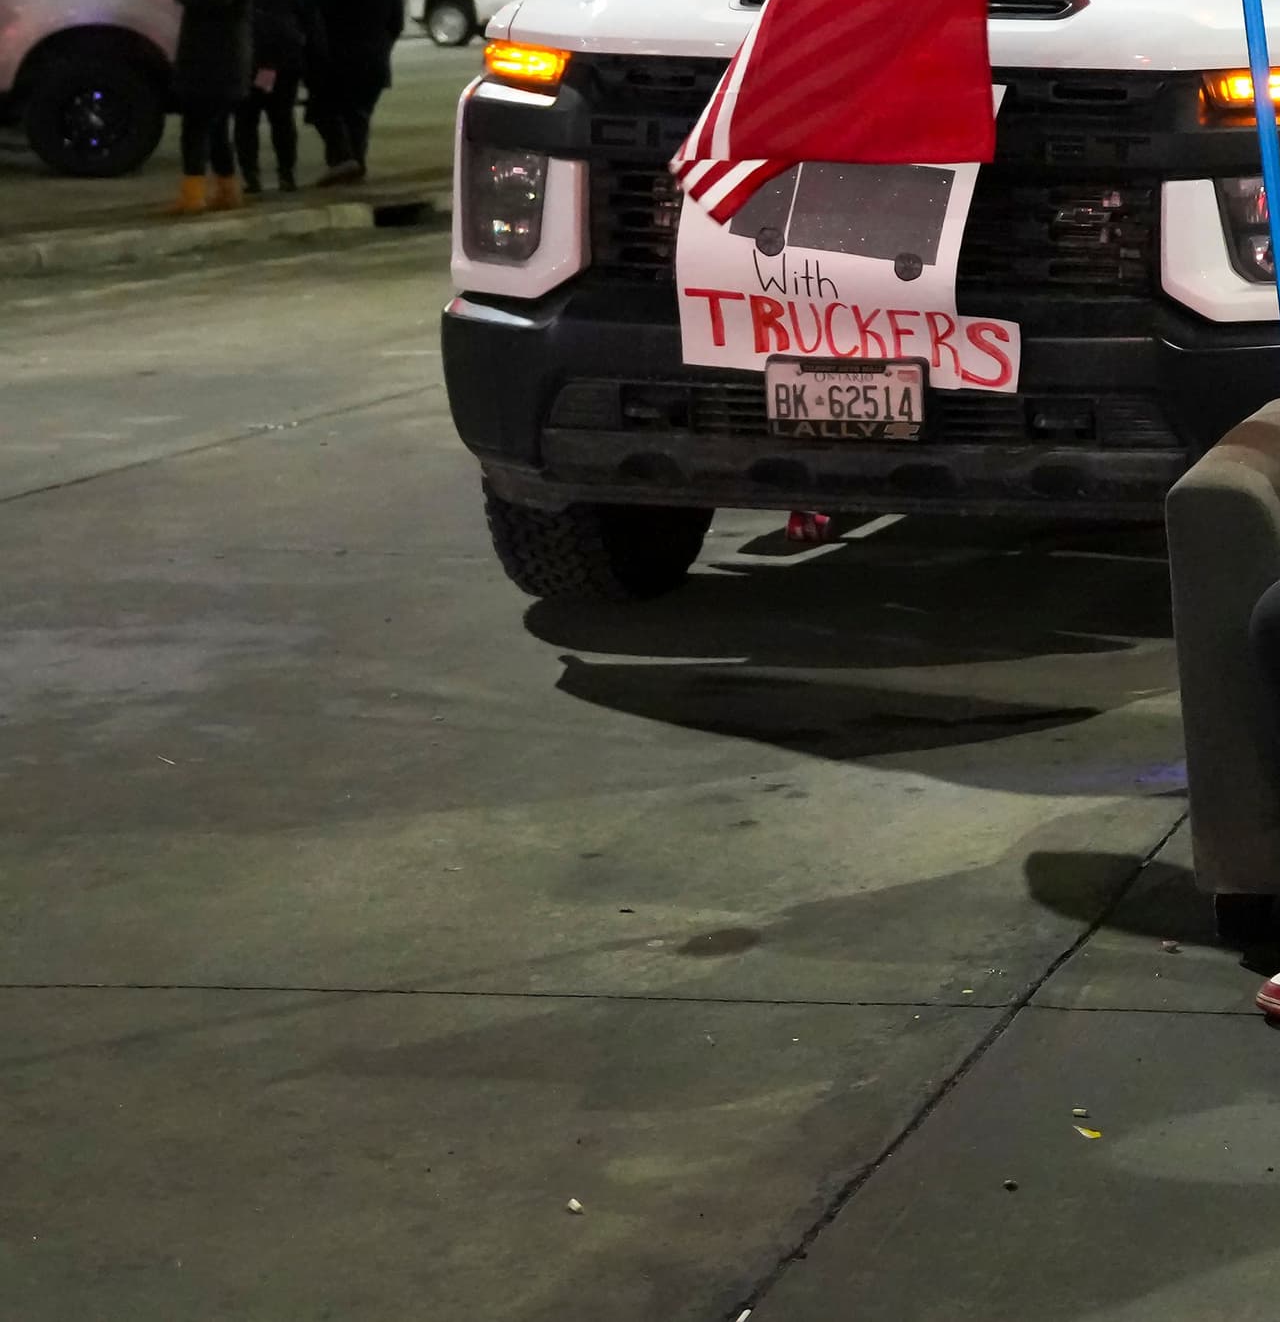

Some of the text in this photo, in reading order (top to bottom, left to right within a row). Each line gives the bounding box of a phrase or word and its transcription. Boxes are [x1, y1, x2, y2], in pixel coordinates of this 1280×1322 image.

[752, 248, 839, 300] With
[684, 287, 1013, 387] TRUCKERS
[775, 383, 913, 422] BK 62514
[773, 422, 877, 438] LALLY
